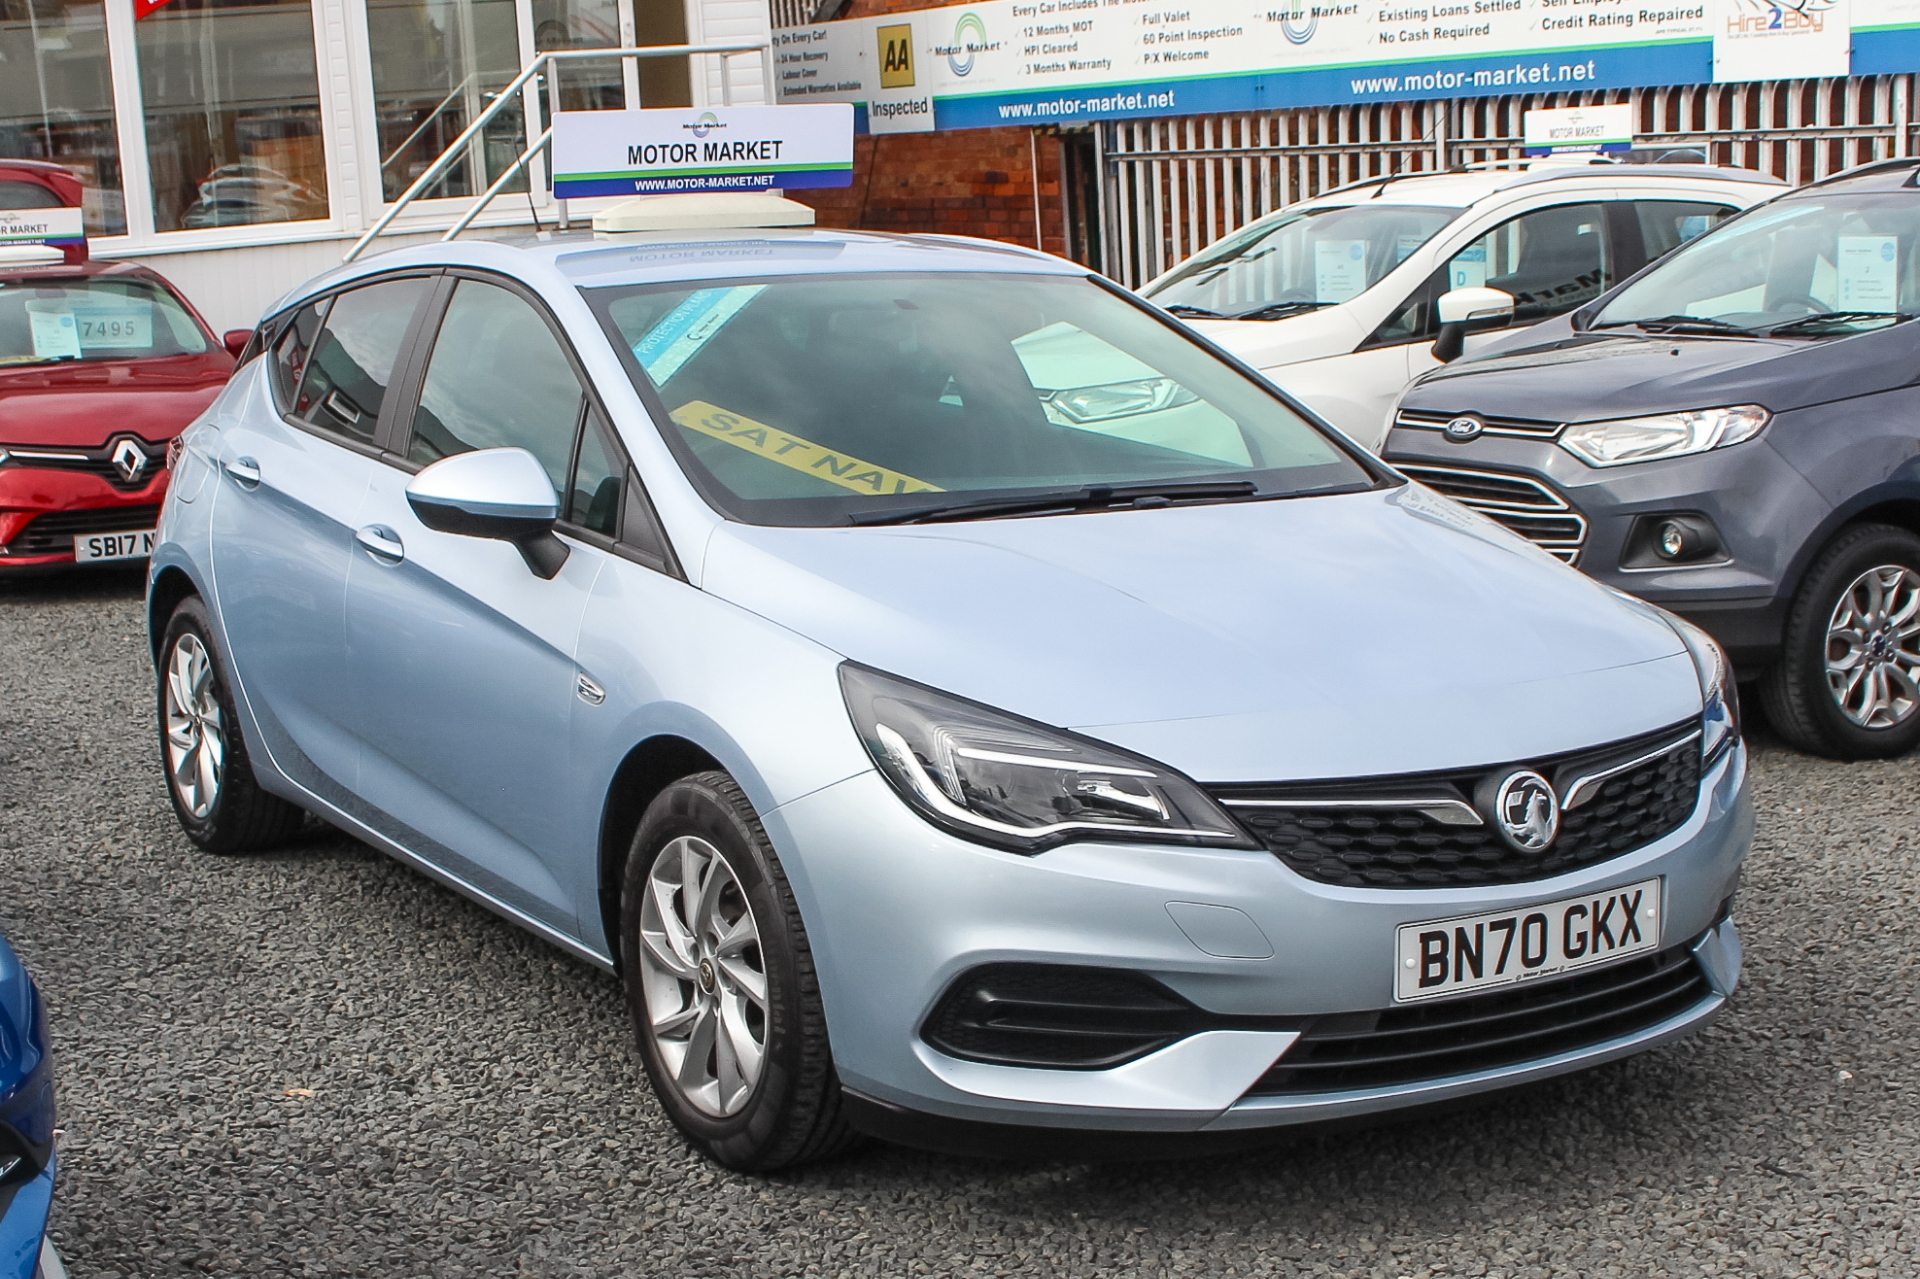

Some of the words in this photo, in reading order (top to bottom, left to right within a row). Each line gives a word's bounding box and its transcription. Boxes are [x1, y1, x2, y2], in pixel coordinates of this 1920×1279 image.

[1013, 6, 1036, 17] Every
[1040, 3, 1055, 13] Car
[1059, 0, 1098, 11] Includes
[1266, 11, 1304, 22] Motor
[1311, 4, 1358, 18] Market
[1379, 9, 1428, 22] Existing
[1432, 5, 1470, 17] Loans
[1474, 0, 1521, 13] Settled
[1143, 13, 1160, 25] Full
[1164, 11, 1190, 22] Valet
[1542, 15, 1583, 30] Credit
[1588, 13, 1634, 27] Rating
[1639, 6, 1703, 24] Repaired
[1024, 26, 1033, 37] 12
[1037, 24, 1069, 36] Months
[1073, 20, 1093, 32] MOT
[1143, 33, 1155, 44] 60
[1159, 31, 1184, 42] Point
[1188, 26, 1243, 41] Inspection
[1379, 32, 1395, 43] No
[1400, 29, 1429, 42] Cash
[1434, 23, 1490, 40] Required
[884, 39, 909, 73] AA
[935, 46, 962, 55] Motor
[967, 41, 1000, 52] Market
[1024, 45, 1039, 56] HPI
[1043, 42, 1078, 54] Cleared
[1164, 50, 1209, 62] Welcome
[1026, 64, 1031, 74] 3
[1033, 62, 1066, 74] Months
[1069, 59, 1112, 71] Warranty
[1351, 60, 1595, 94] www.motor-market.net
[872, 98, 928, 119] Inspected
[998, 90, 1175, 118] www.motor-market.net
[1549, 128, 1574, 138] MOTOR
[1576, 125, 1605, 137] MARKET
[628, 144, 698, 165] MOTOR
[703, 140, 783, 162] MARKET
[635, 175, 775, 191] WWW.MOTOR-MARKET.NET
[10, 224, 48, 233] MARKET
[1457, 271, 1466, 286] D
[83, 321, 135, 337] 7495
[701, 412, 811, 456] SAT
[89, 535, 136, 558] SB17
[1418, 911, 1549, 989] BN70
[1562, 889, 1643, 960] GKX
